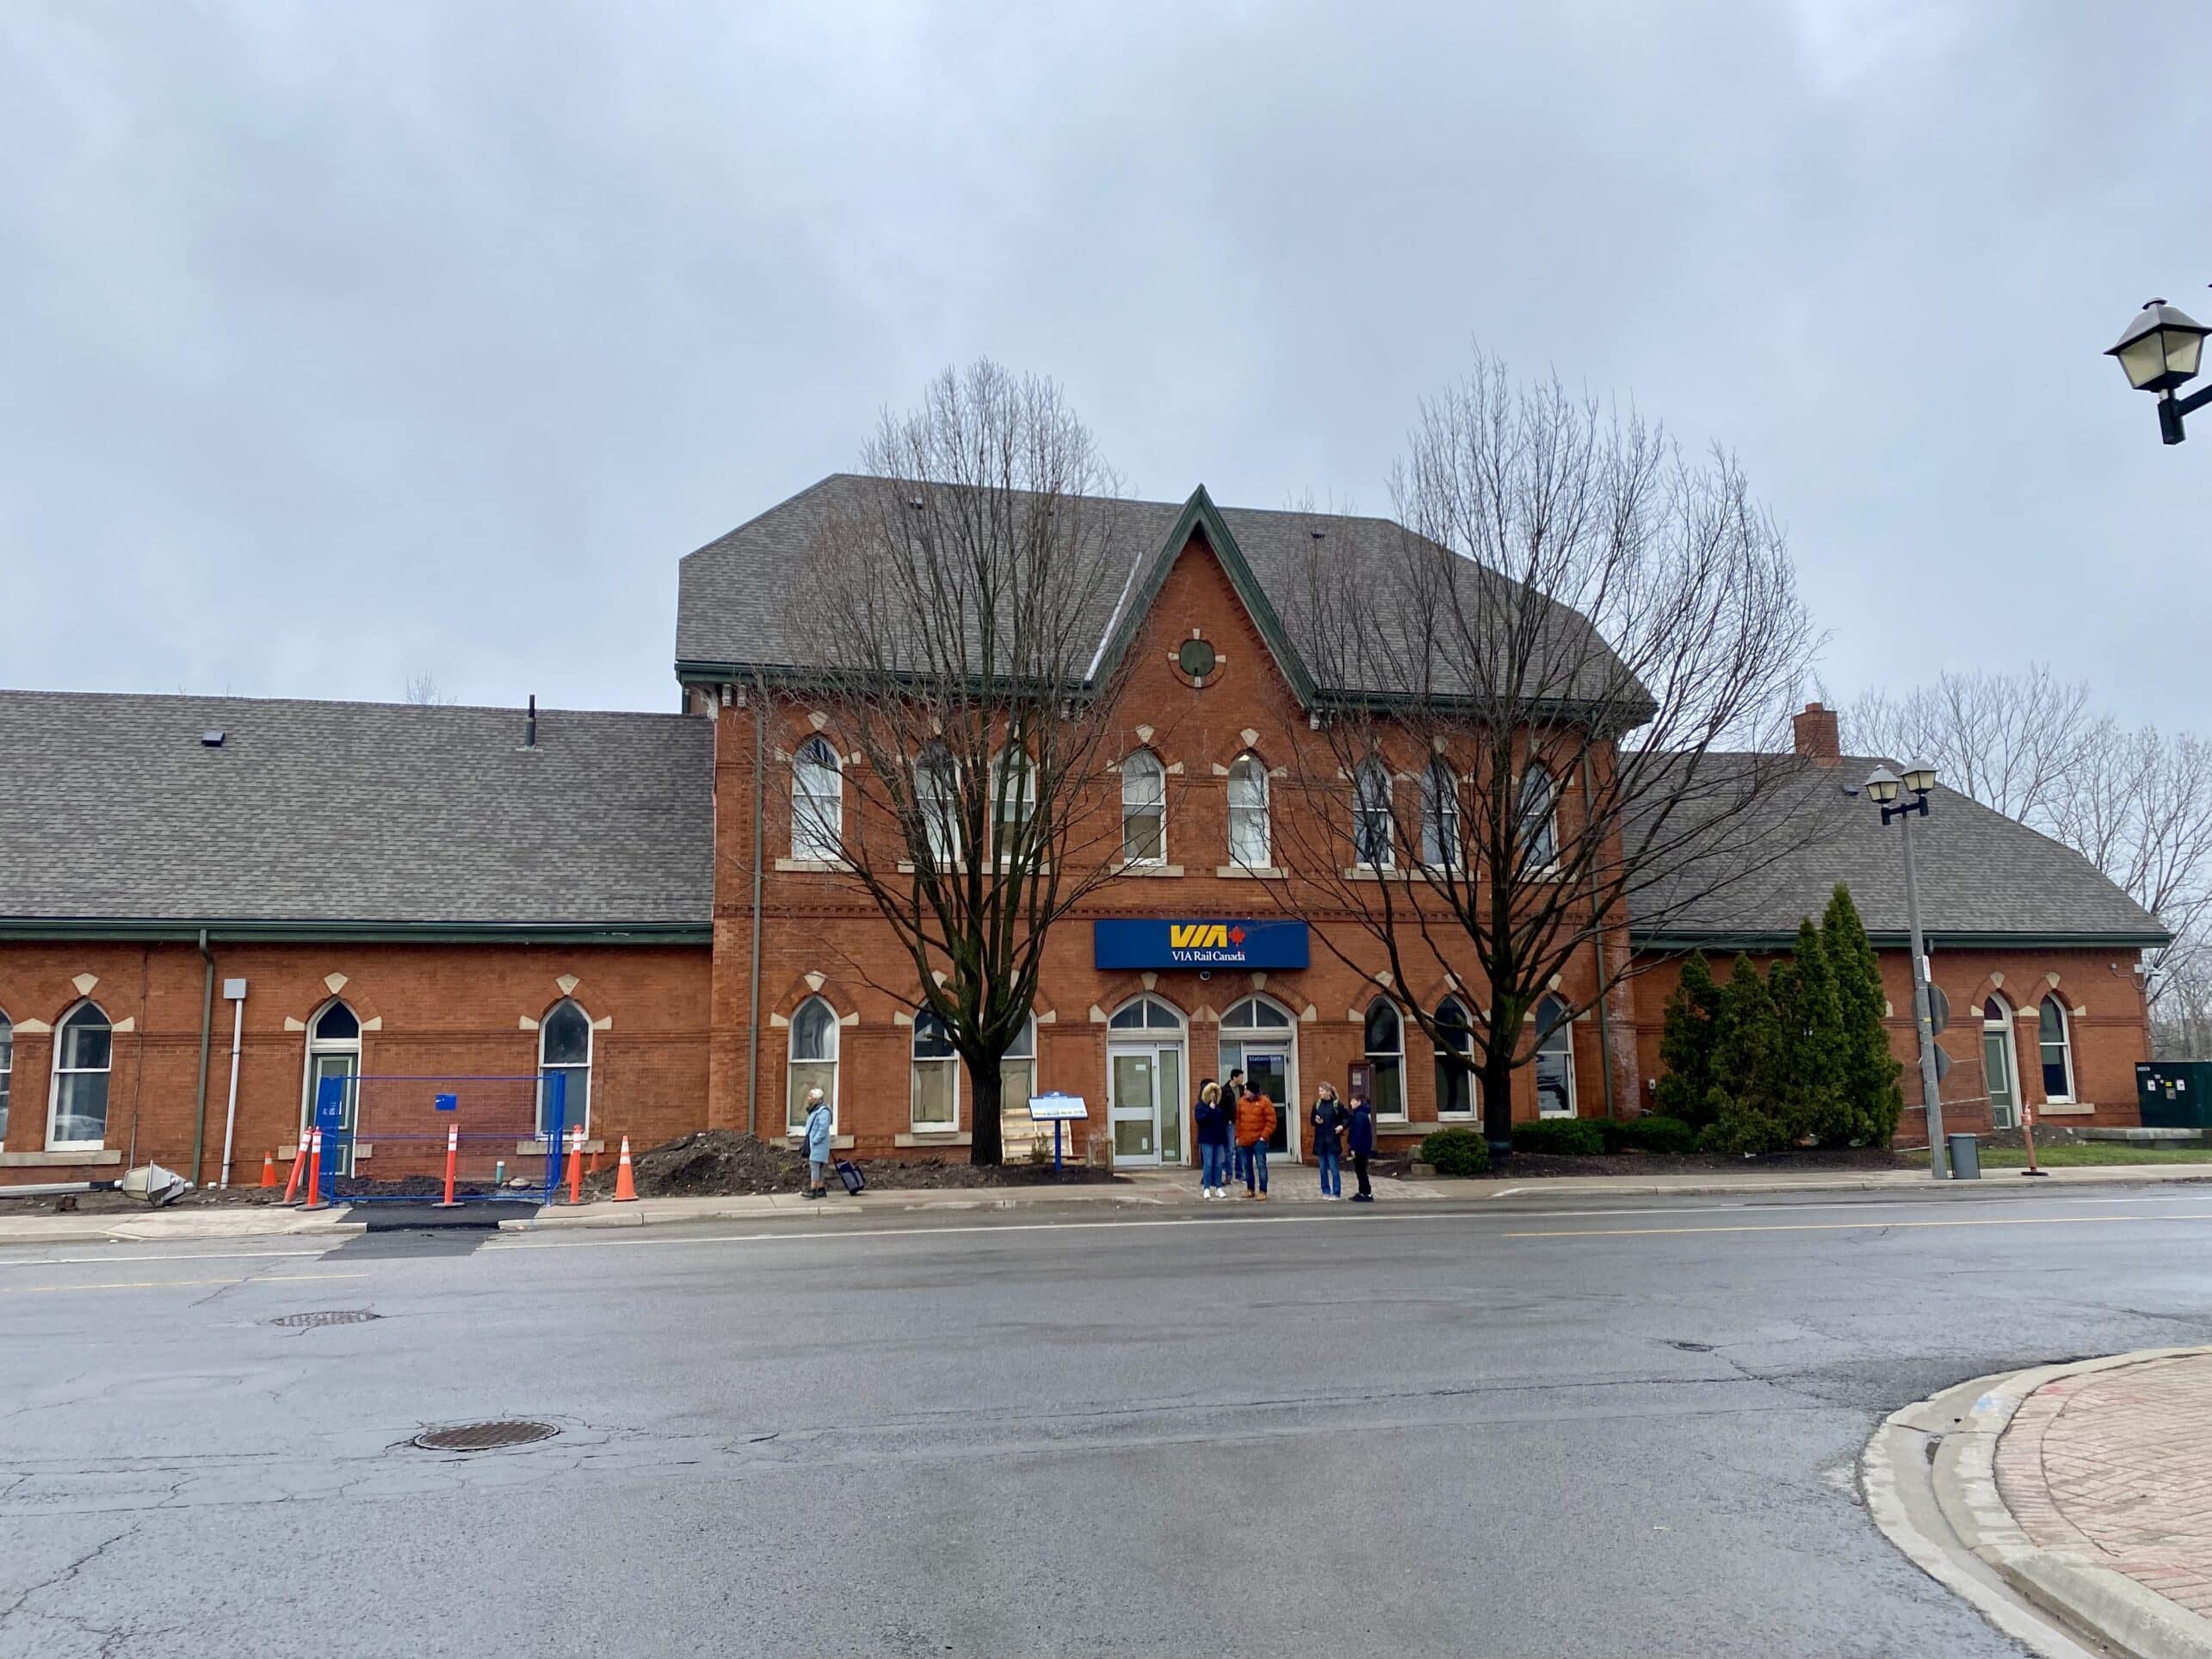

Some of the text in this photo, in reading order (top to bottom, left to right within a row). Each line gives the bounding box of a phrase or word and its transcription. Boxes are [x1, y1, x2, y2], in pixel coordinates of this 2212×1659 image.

[1171, 925, 1227, 948] VIA
[1171, 950, 1245, 961] VIA Rail Canada
